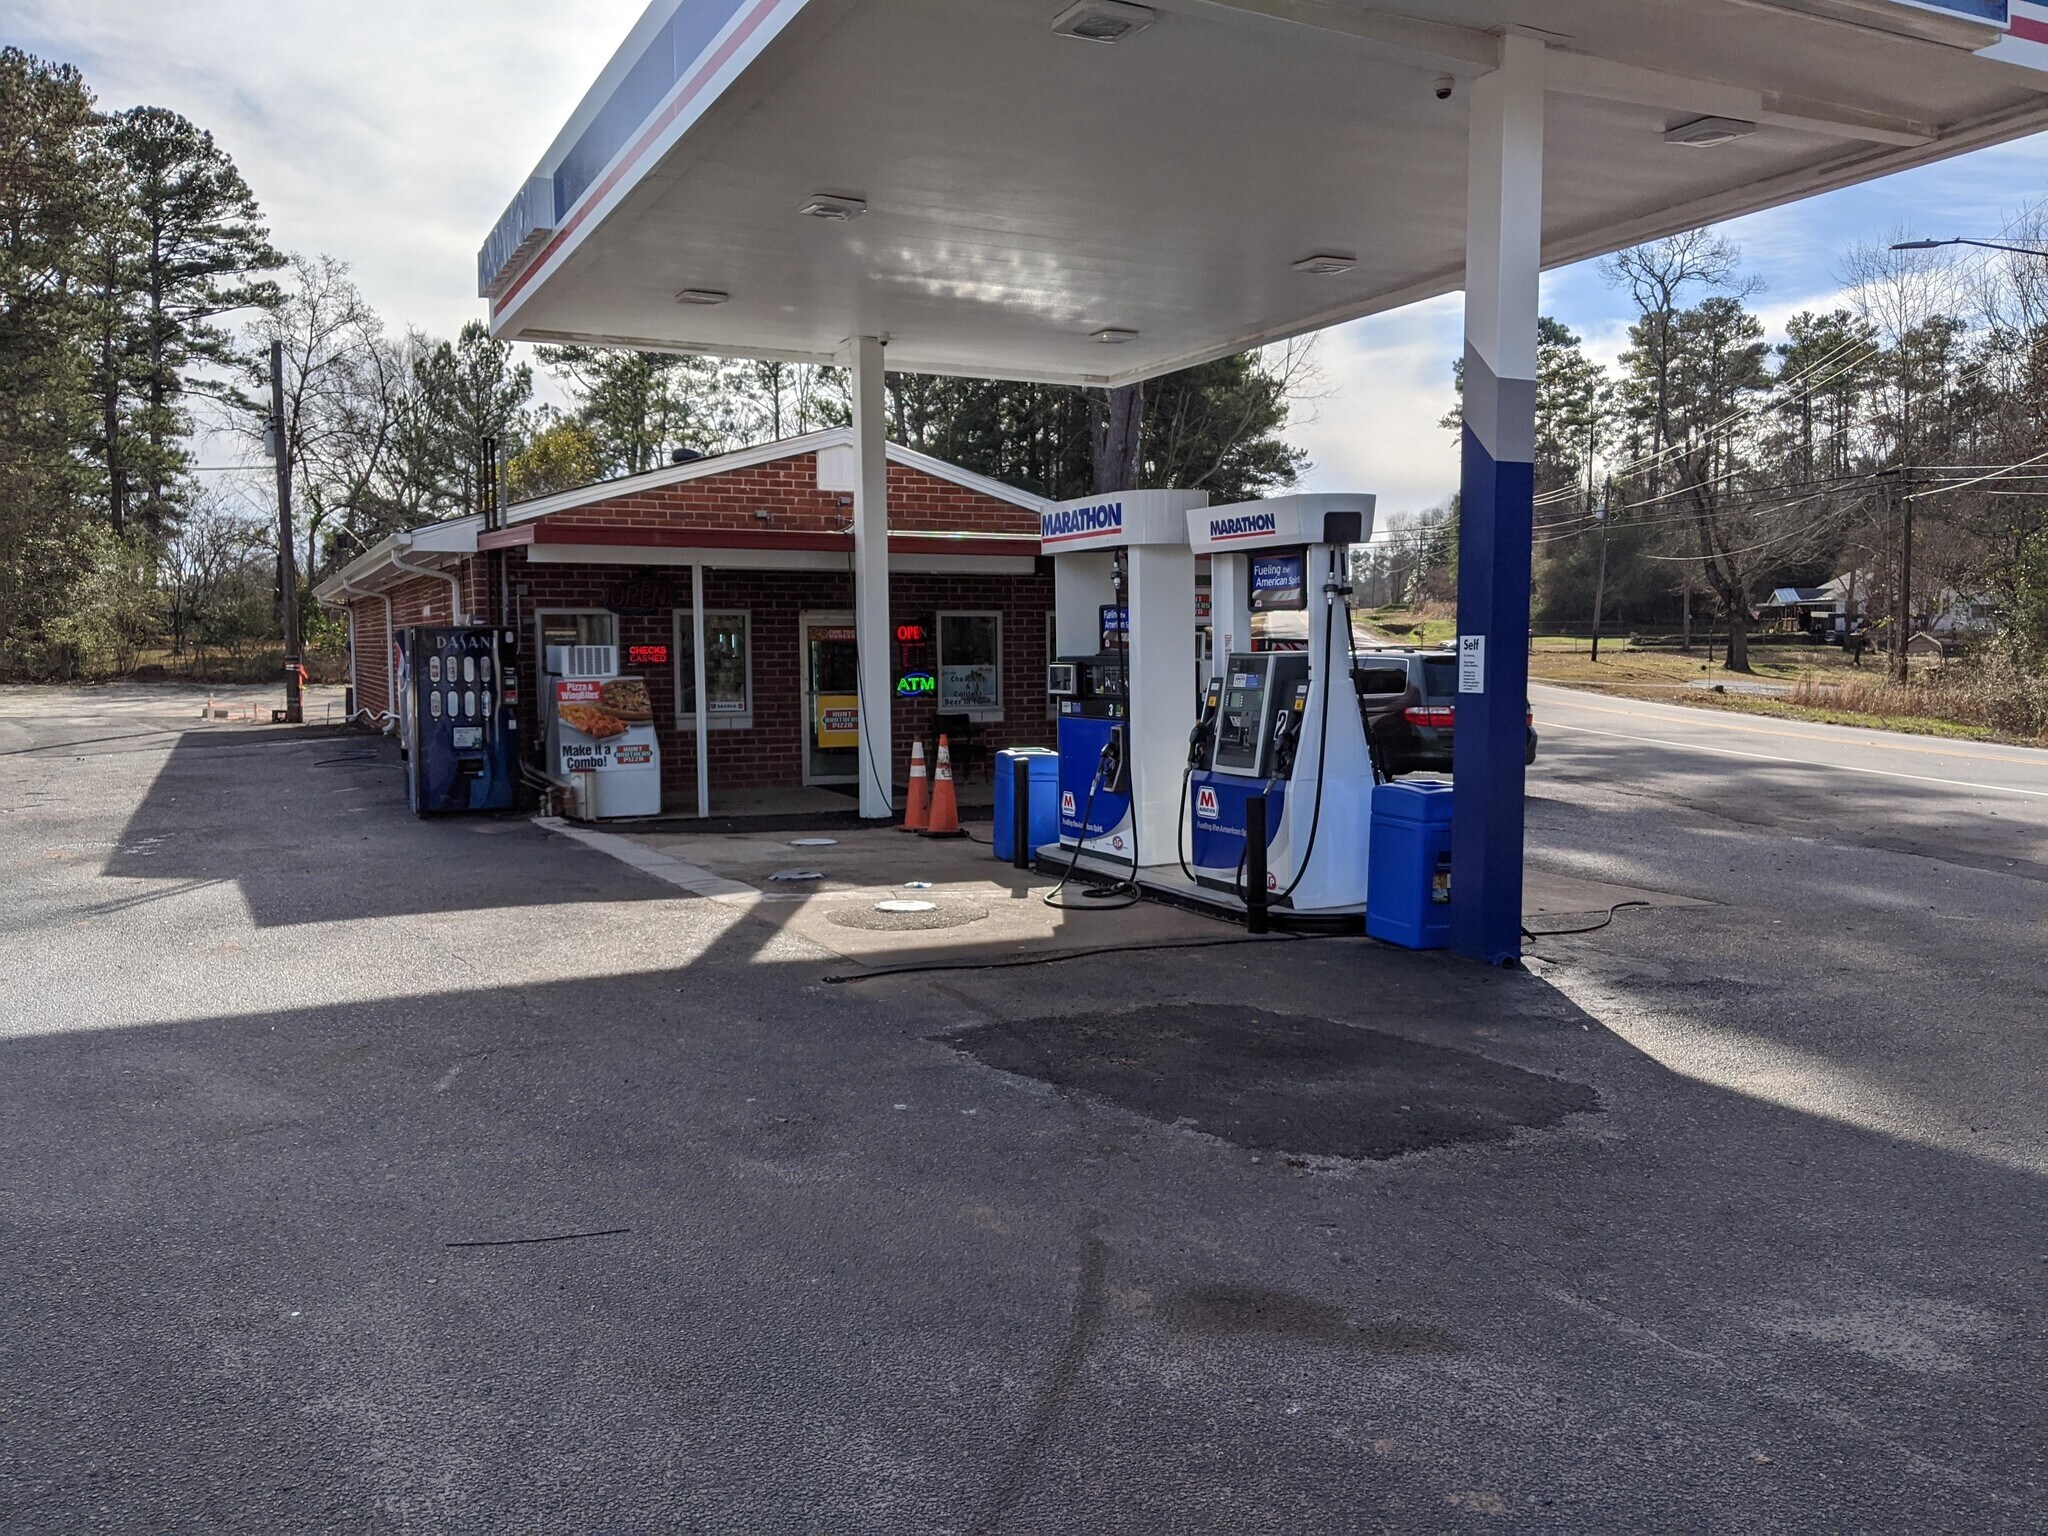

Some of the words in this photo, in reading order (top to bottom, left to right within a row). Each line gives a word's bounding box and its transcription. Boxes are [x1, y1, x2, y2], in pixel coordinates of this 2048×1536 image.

[1042, 502, 1121, 537] MARATHON
[1210, 513, 1275, 536] MARATHON
[1254, 565, 1281, 576] Fueling
[1256, 577, 1288, 587] American
[1103, 610, 1118, 619] Fuelin
[897, 625, 928, 640] OPEN
[436, 634, 493, 650] DASAN
[1463, 639, 1479, 651] Self
[629, 646, 667, 655] CHECKS
[566, 683, 587, 691] Pizza
[898, 677, 934, 690] ATM
[561, 692, 598, 700] WingBites
[1108, 704, 1114, 717] 3
[1275, 711, 1287, 739] 2
[562, 745, 592, 757] Make
[595, 744, 602, 756] it
[604, 745, 611, 755] a
[567, 756, 607, 769] Combo!
[1064, 795, 1073, 807] M
[1200, 791, 1214, 807] M
[1113, 838, 1122, 848] STP
